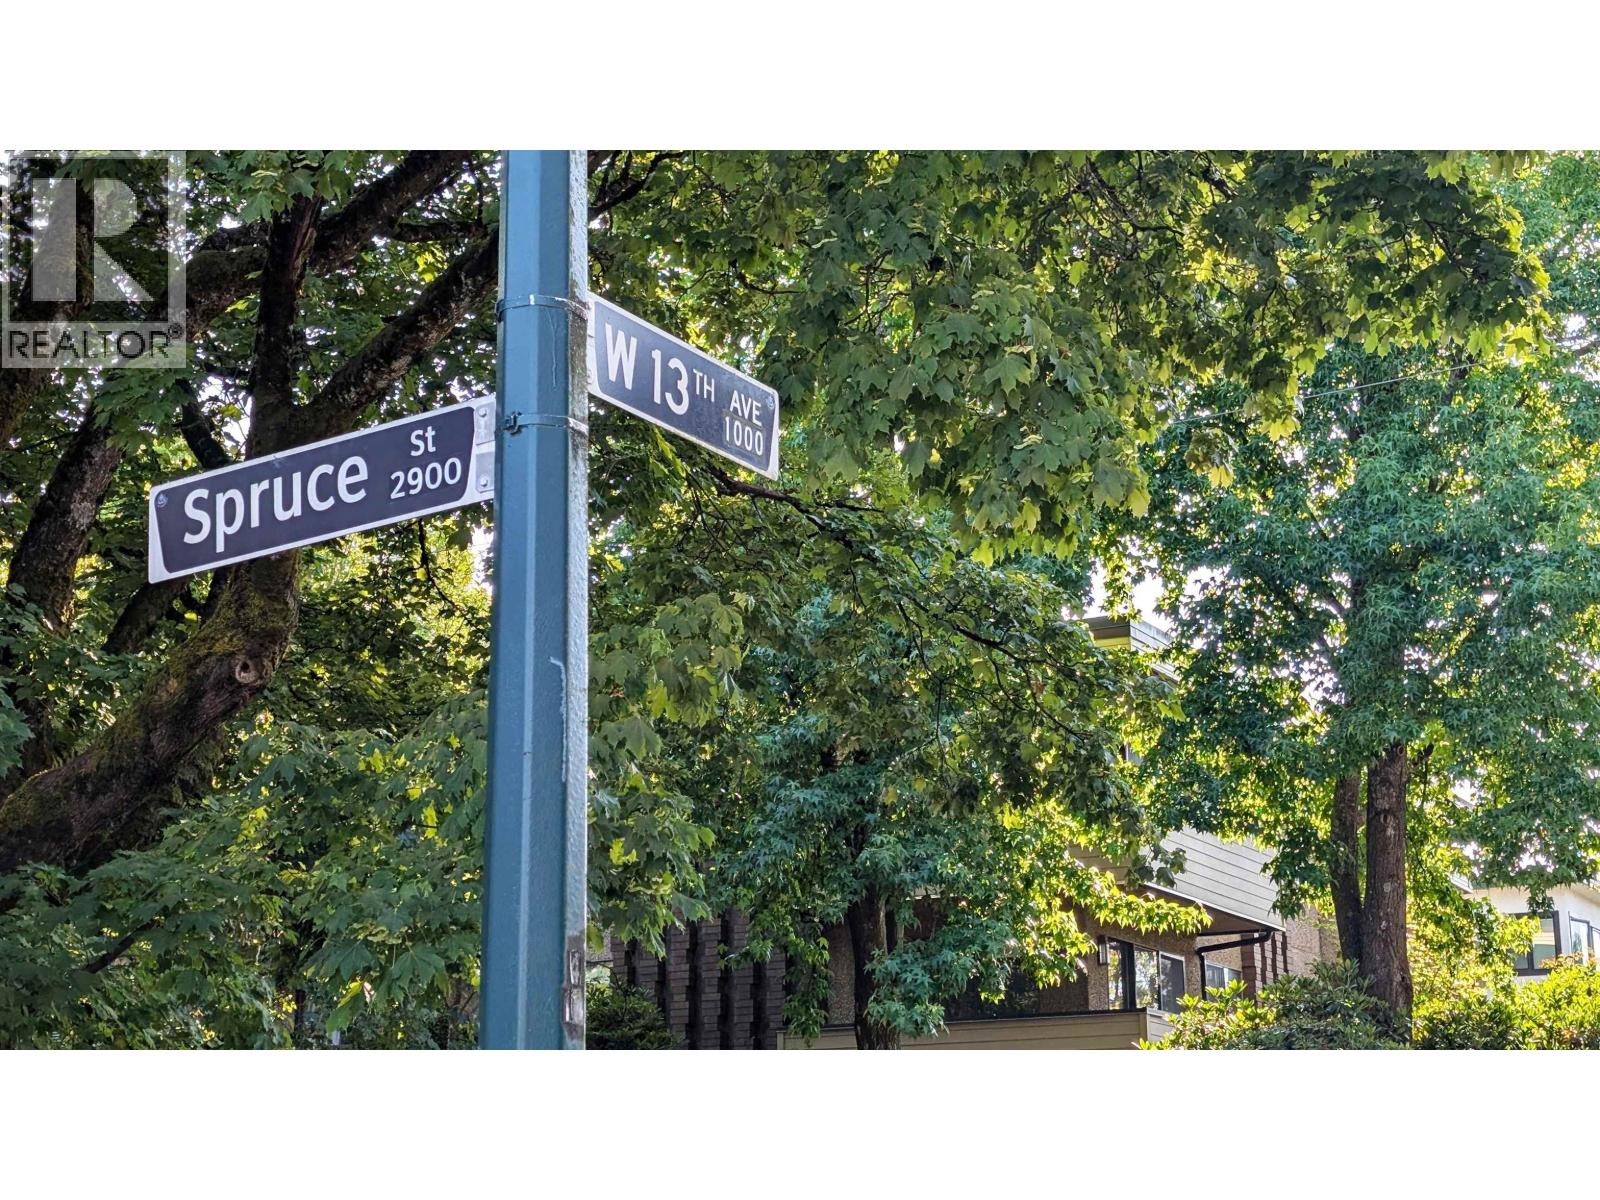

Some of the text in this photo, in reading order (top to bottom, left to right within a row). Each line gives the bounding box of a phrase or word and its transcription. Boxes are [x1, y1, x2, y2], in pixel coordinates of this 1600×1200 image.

[605, 322, 637, 390] W
[729, 390, 762, 426] AVE
[724, 416, 764, 456] 1000
[183, 425, 436, 553] Spruce St
[390, 457, 462, 500] 2900
